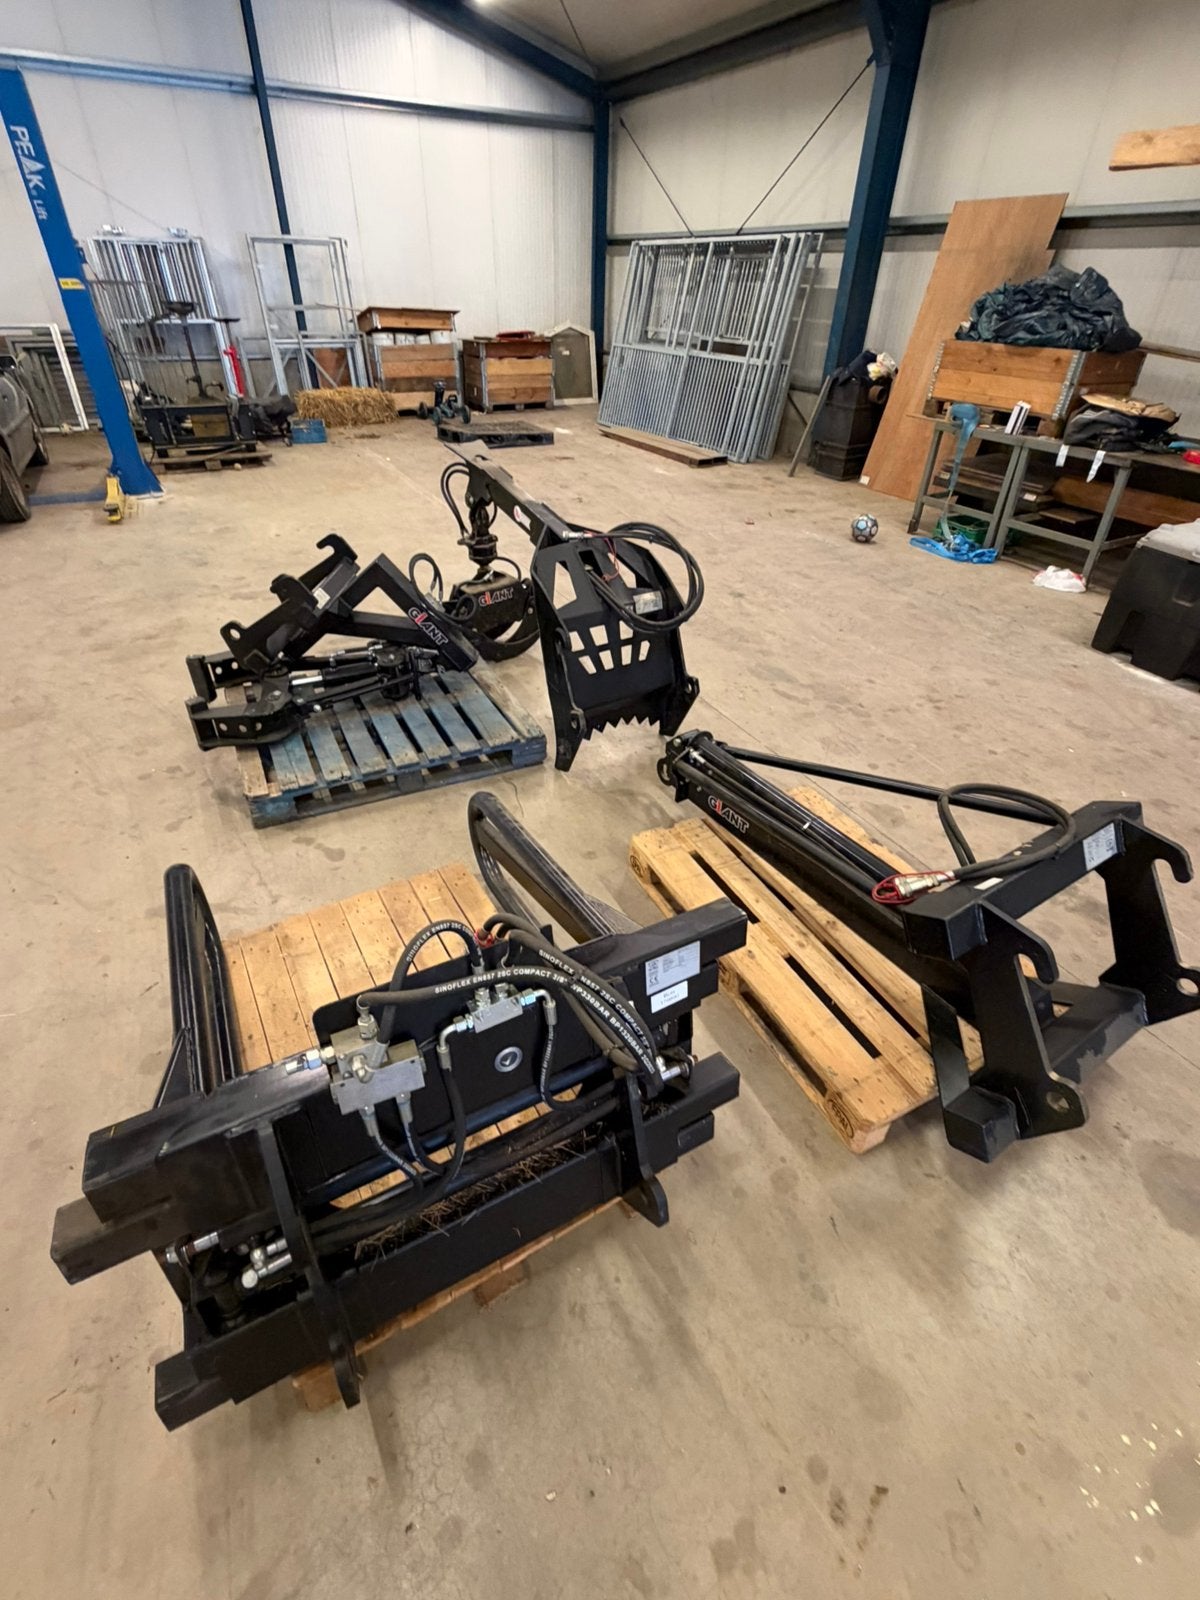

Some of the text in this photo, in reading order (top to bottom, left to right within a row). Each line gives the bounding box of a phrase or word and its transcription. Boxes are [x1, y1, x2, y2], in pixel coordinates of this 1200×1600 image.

[10, 125, 46, 190] PEAK
[478, 587, 514, 607] GIANT
[407, 607, 449, 645] GIANT
[707, 795, 750, 834] GIANT
[434, 978, 471, 994] SINOFLEX
[473, 972, 495, 984] EN857
[497, 969, 512, 979] 2SC
[513, 968, 551, 978] COMPACT
[539, 949, 575, 975] SINOFLEX
[581, 975, 600, 992] N857
[600, 990, 616, 1004] 2SC
[615, 1003, 644, 1035] COMPACT
